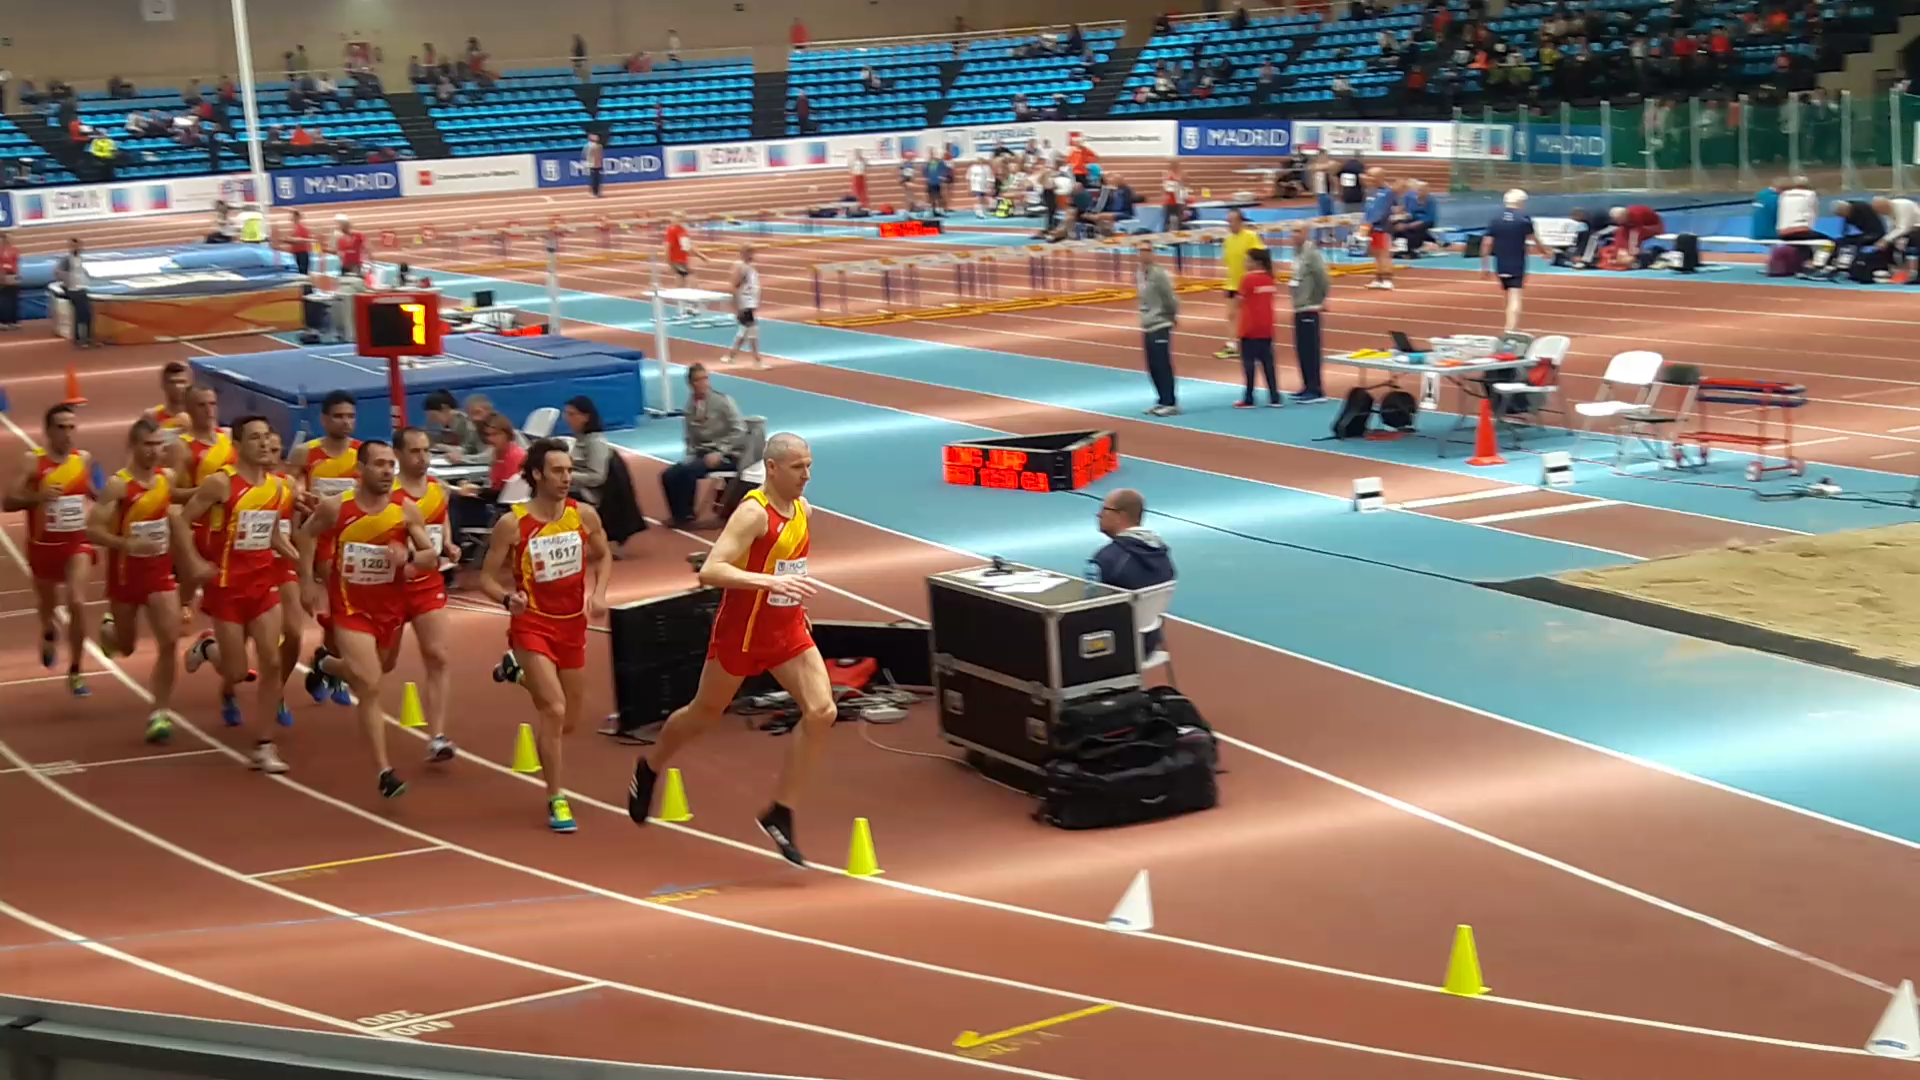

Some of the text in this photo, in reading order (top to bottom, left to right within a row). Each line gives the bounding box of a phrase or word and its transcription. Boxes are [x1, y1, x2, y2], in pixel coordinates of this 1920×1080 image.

[1207, 128, 1289, 147] MADRID
[570, 155, 661, 177] MDRID
[304, 172, 397, 194] MADRID
[400, 303, 426, 345] 7
[548, 545, 577, 560] 1617
